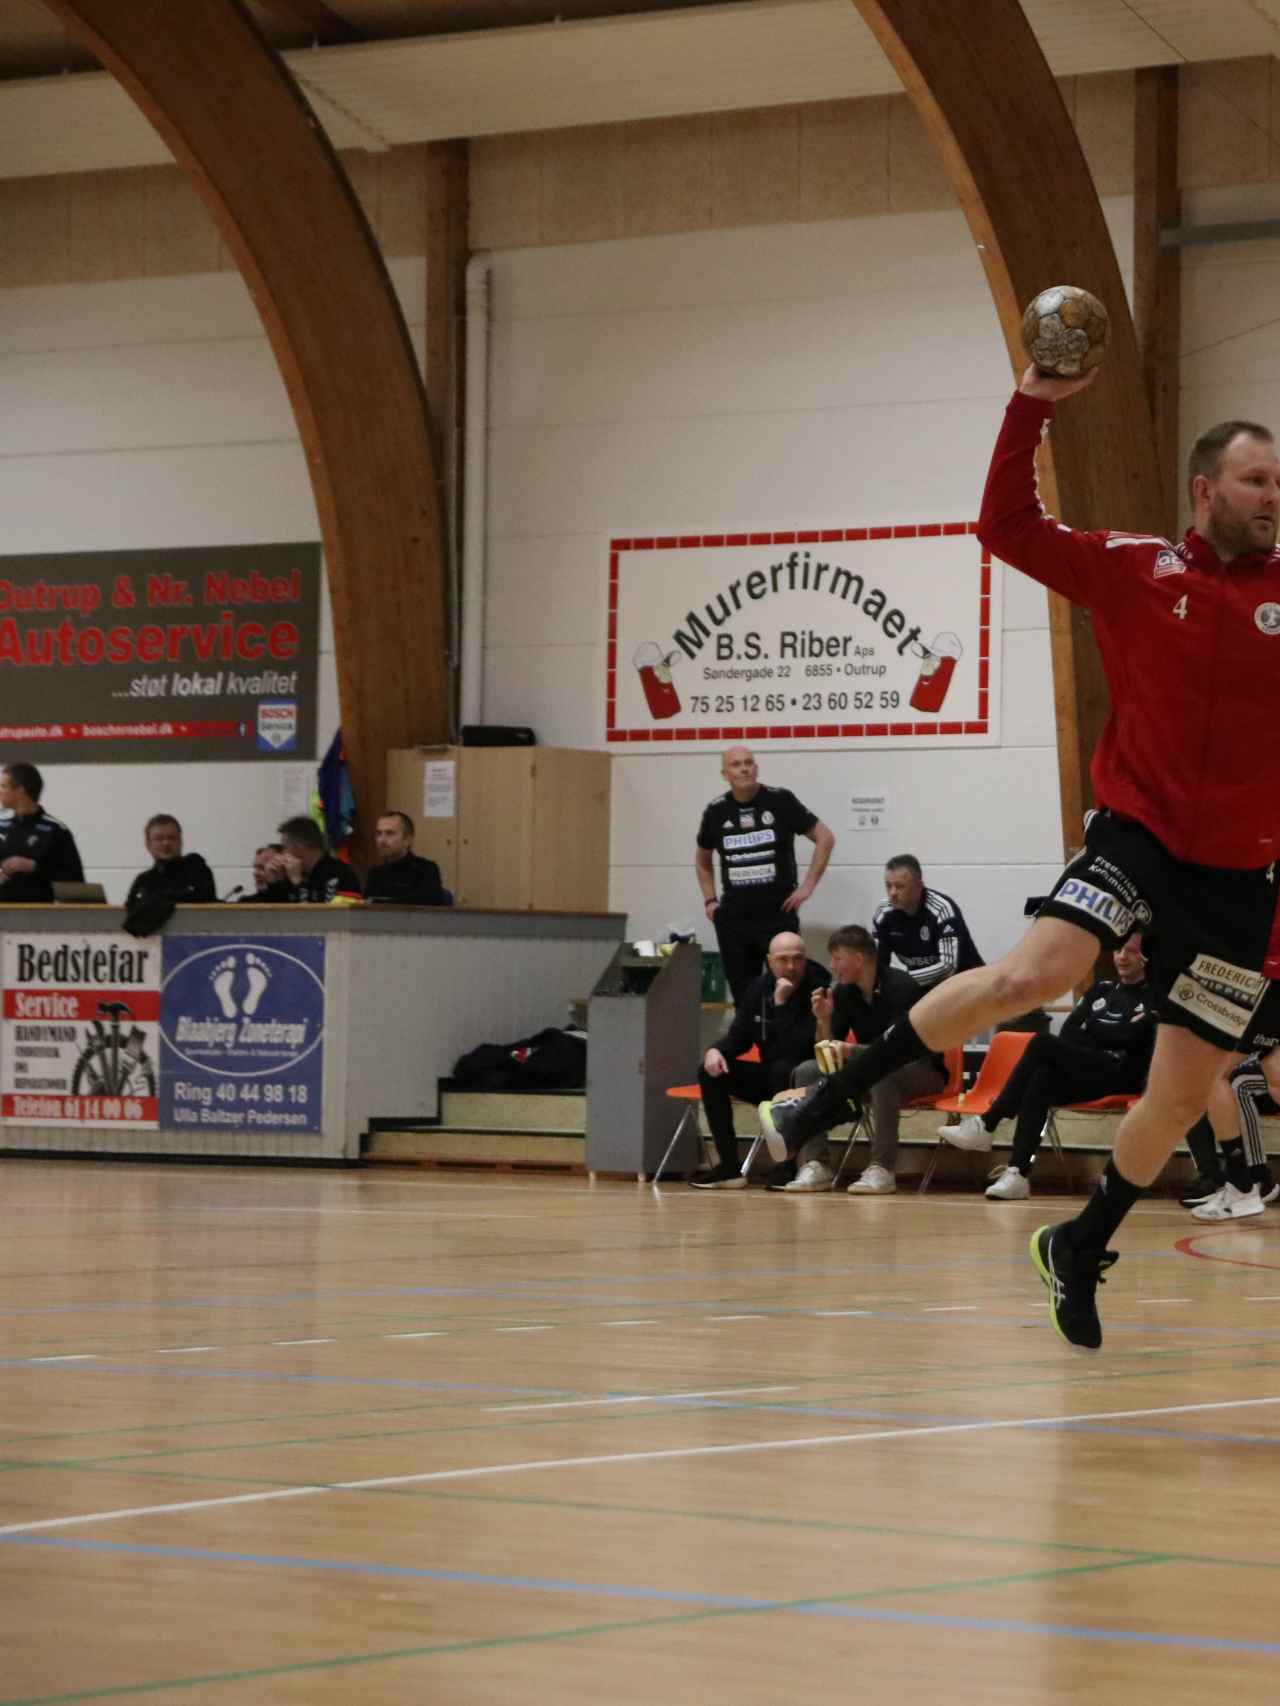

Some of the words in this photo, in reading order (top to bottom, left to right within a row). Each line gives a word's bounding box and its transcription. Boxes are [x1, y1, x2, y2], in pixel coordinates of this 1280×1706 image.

[110, 574, 136, 608] &
[147, 572, 194, 607] Nr.
[204, 568, 302, 604] Nebel
[672, 552, 922, 661] Murerfirmaet
[1172, 594, 1188, 620] 4
[0, 611, 299, 666] Autoservice
[716, 632, 769, 661] B.S.
[780, 630, 853, 659] Riber
[854, 645, 875, 657] Aps
[170, 671, 224, 697] lokal
[225, 671, 298, 695] kvalitet
[703, 665, 774, 681] Søndergade
[777, 666, 791, 678] 22
[805, 664, 833, 677] 6855
[844, 663, 887, 677] Outrup
[690, 696, 710, 713] 75
[715, 696, 735, 712] 25
[741, 695, 760, 712] 12
[765, 695, 785, 711] 65
[802, 694, 822, 711] 23
[827, 693, 848, 710] 60
[853, 692, 874, 709] 52
[880, 691, 900, 709] 59
[17, 943, 149, 984] Bedstefar
[14, 991, 80, 1018] Service
[173, 1082, 213, 1106] Ring
[216, 1083, 237, 1102] 40
[239, 1084, 260, 1102] 44
[263, 1084, 284, 1103] 98
[288, 1084, 308, 1104] 18
[247, 1110, 308, 1125] Pedersen
